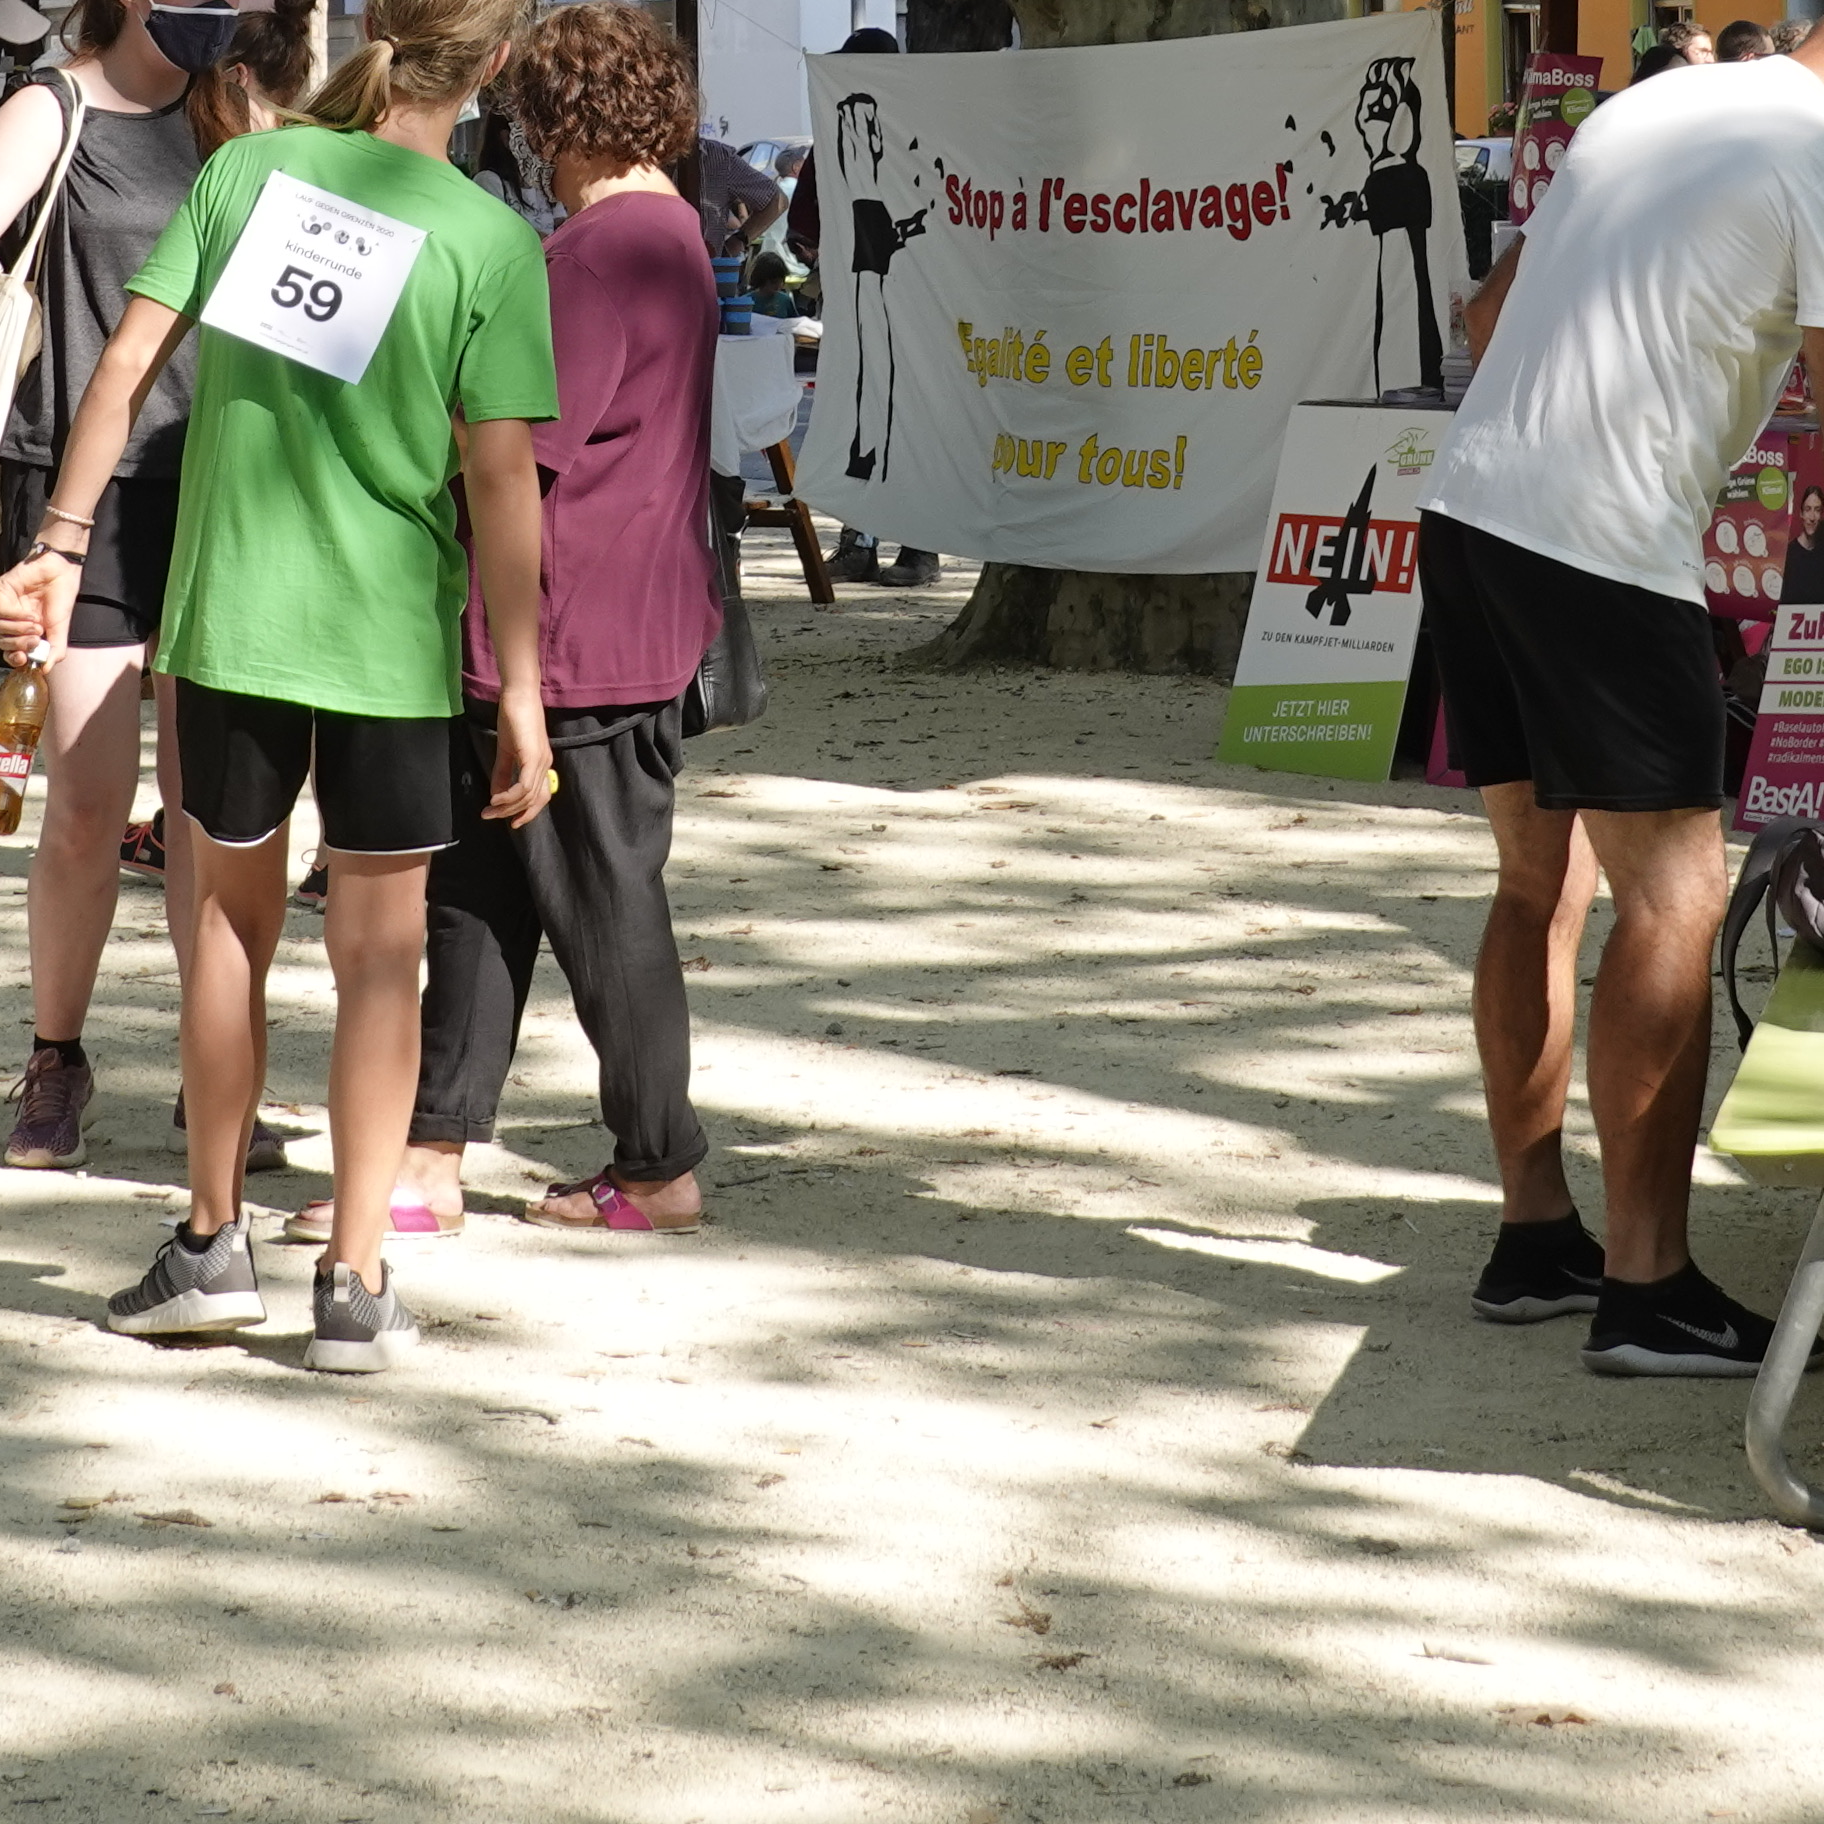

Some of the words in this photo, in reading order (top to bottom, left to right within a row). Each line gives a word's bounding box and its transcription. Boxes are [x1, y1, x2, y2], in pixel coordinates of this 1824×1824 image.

[945, 174, 1005, 242] Stop
[1012, 176, 1028, 231] à
[1038, 162, 1291, 242] l'esclavage!
[284, 240, 363, 280] kinderrunde
[271, 264, 343, 323] 59
[1065, 335, 1114, 388] et
[1128, 329, 1264, 392] liberté
[992, 432, 1067, 482] pour
[1078, 433, 1188, 490] tous!
[1274, 522, 1416, 585] NEIN!
[1261, 630, 1273, 643] ZU
[1275, 631, 1293, 644] DEN
[1294, 633, 1395, 653] KAMPFJET-MILLIARDEN
[1783, 657, 1814, 675] EGO
[1272, 699, 1315, 718] JETZT
[1316, 699, 1351, 717] HIER
[1243, 724, 1373, 743] UNTERSCHREIBEN!
[1770, 736, 1817, 749] #NoBorder
